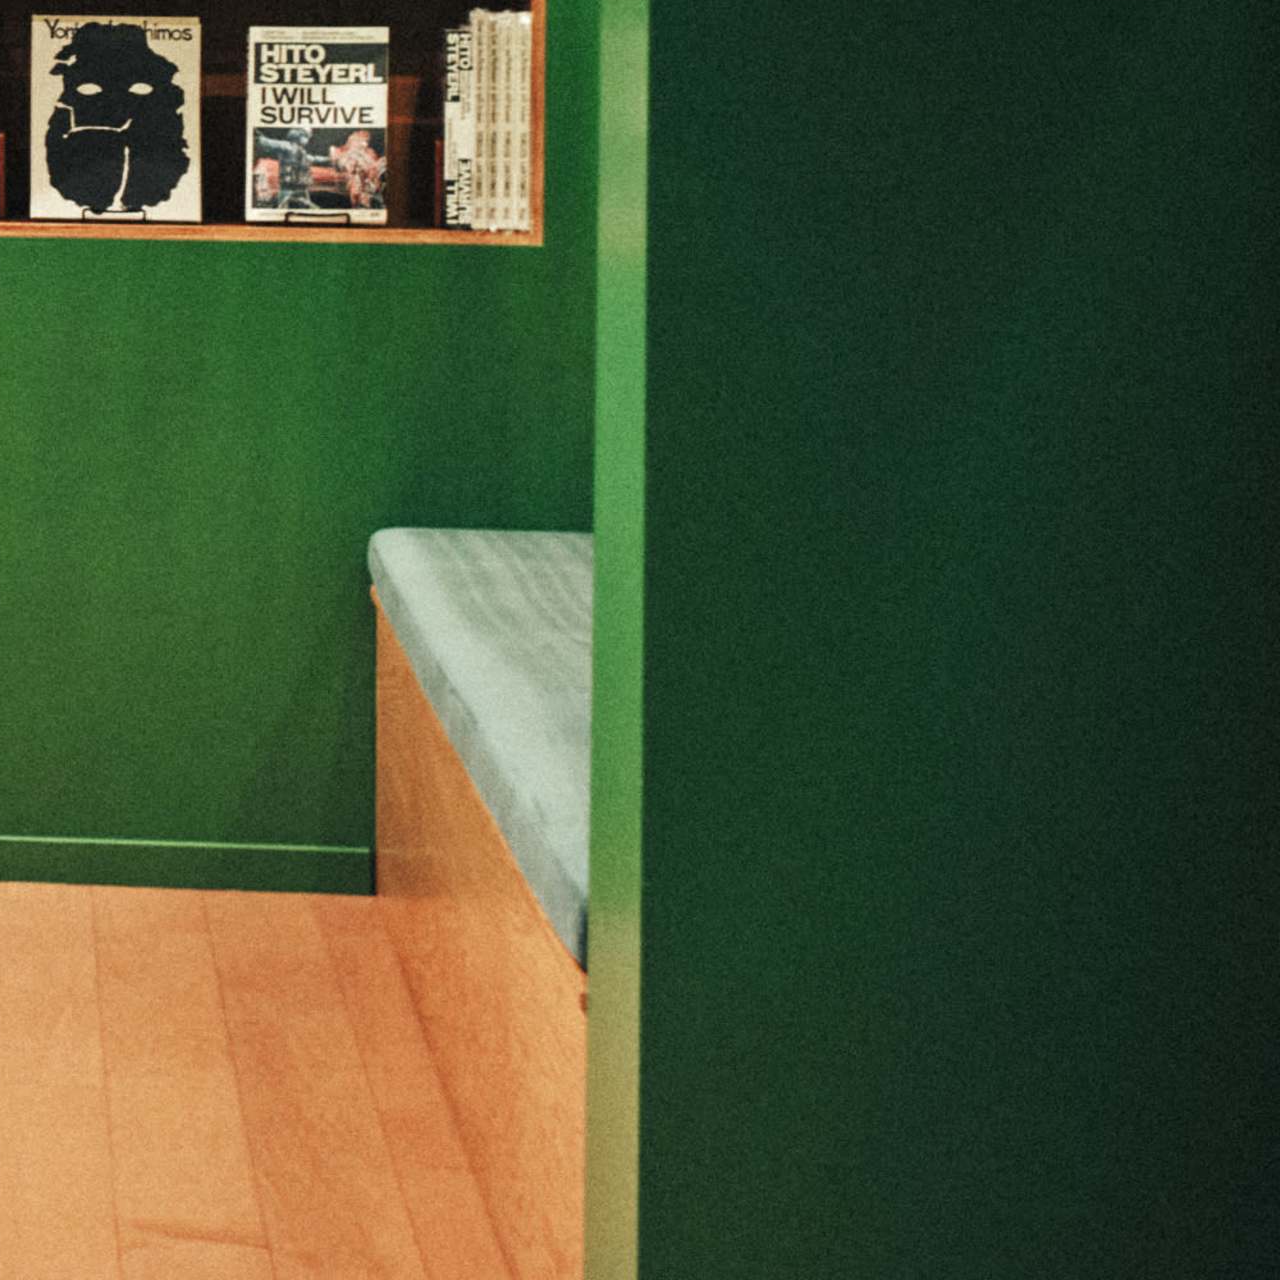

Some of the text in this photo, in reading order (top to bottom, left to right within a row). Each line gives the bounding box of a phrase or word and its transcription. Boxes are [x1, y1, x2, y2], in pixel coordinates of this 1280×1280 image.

[261, 44, 326, 64] HITO
[260, 63, 383, 83] STEYERL
[261, 87, 335, 104] I WILL
[261, 106, 374, 124] SURVIVE
